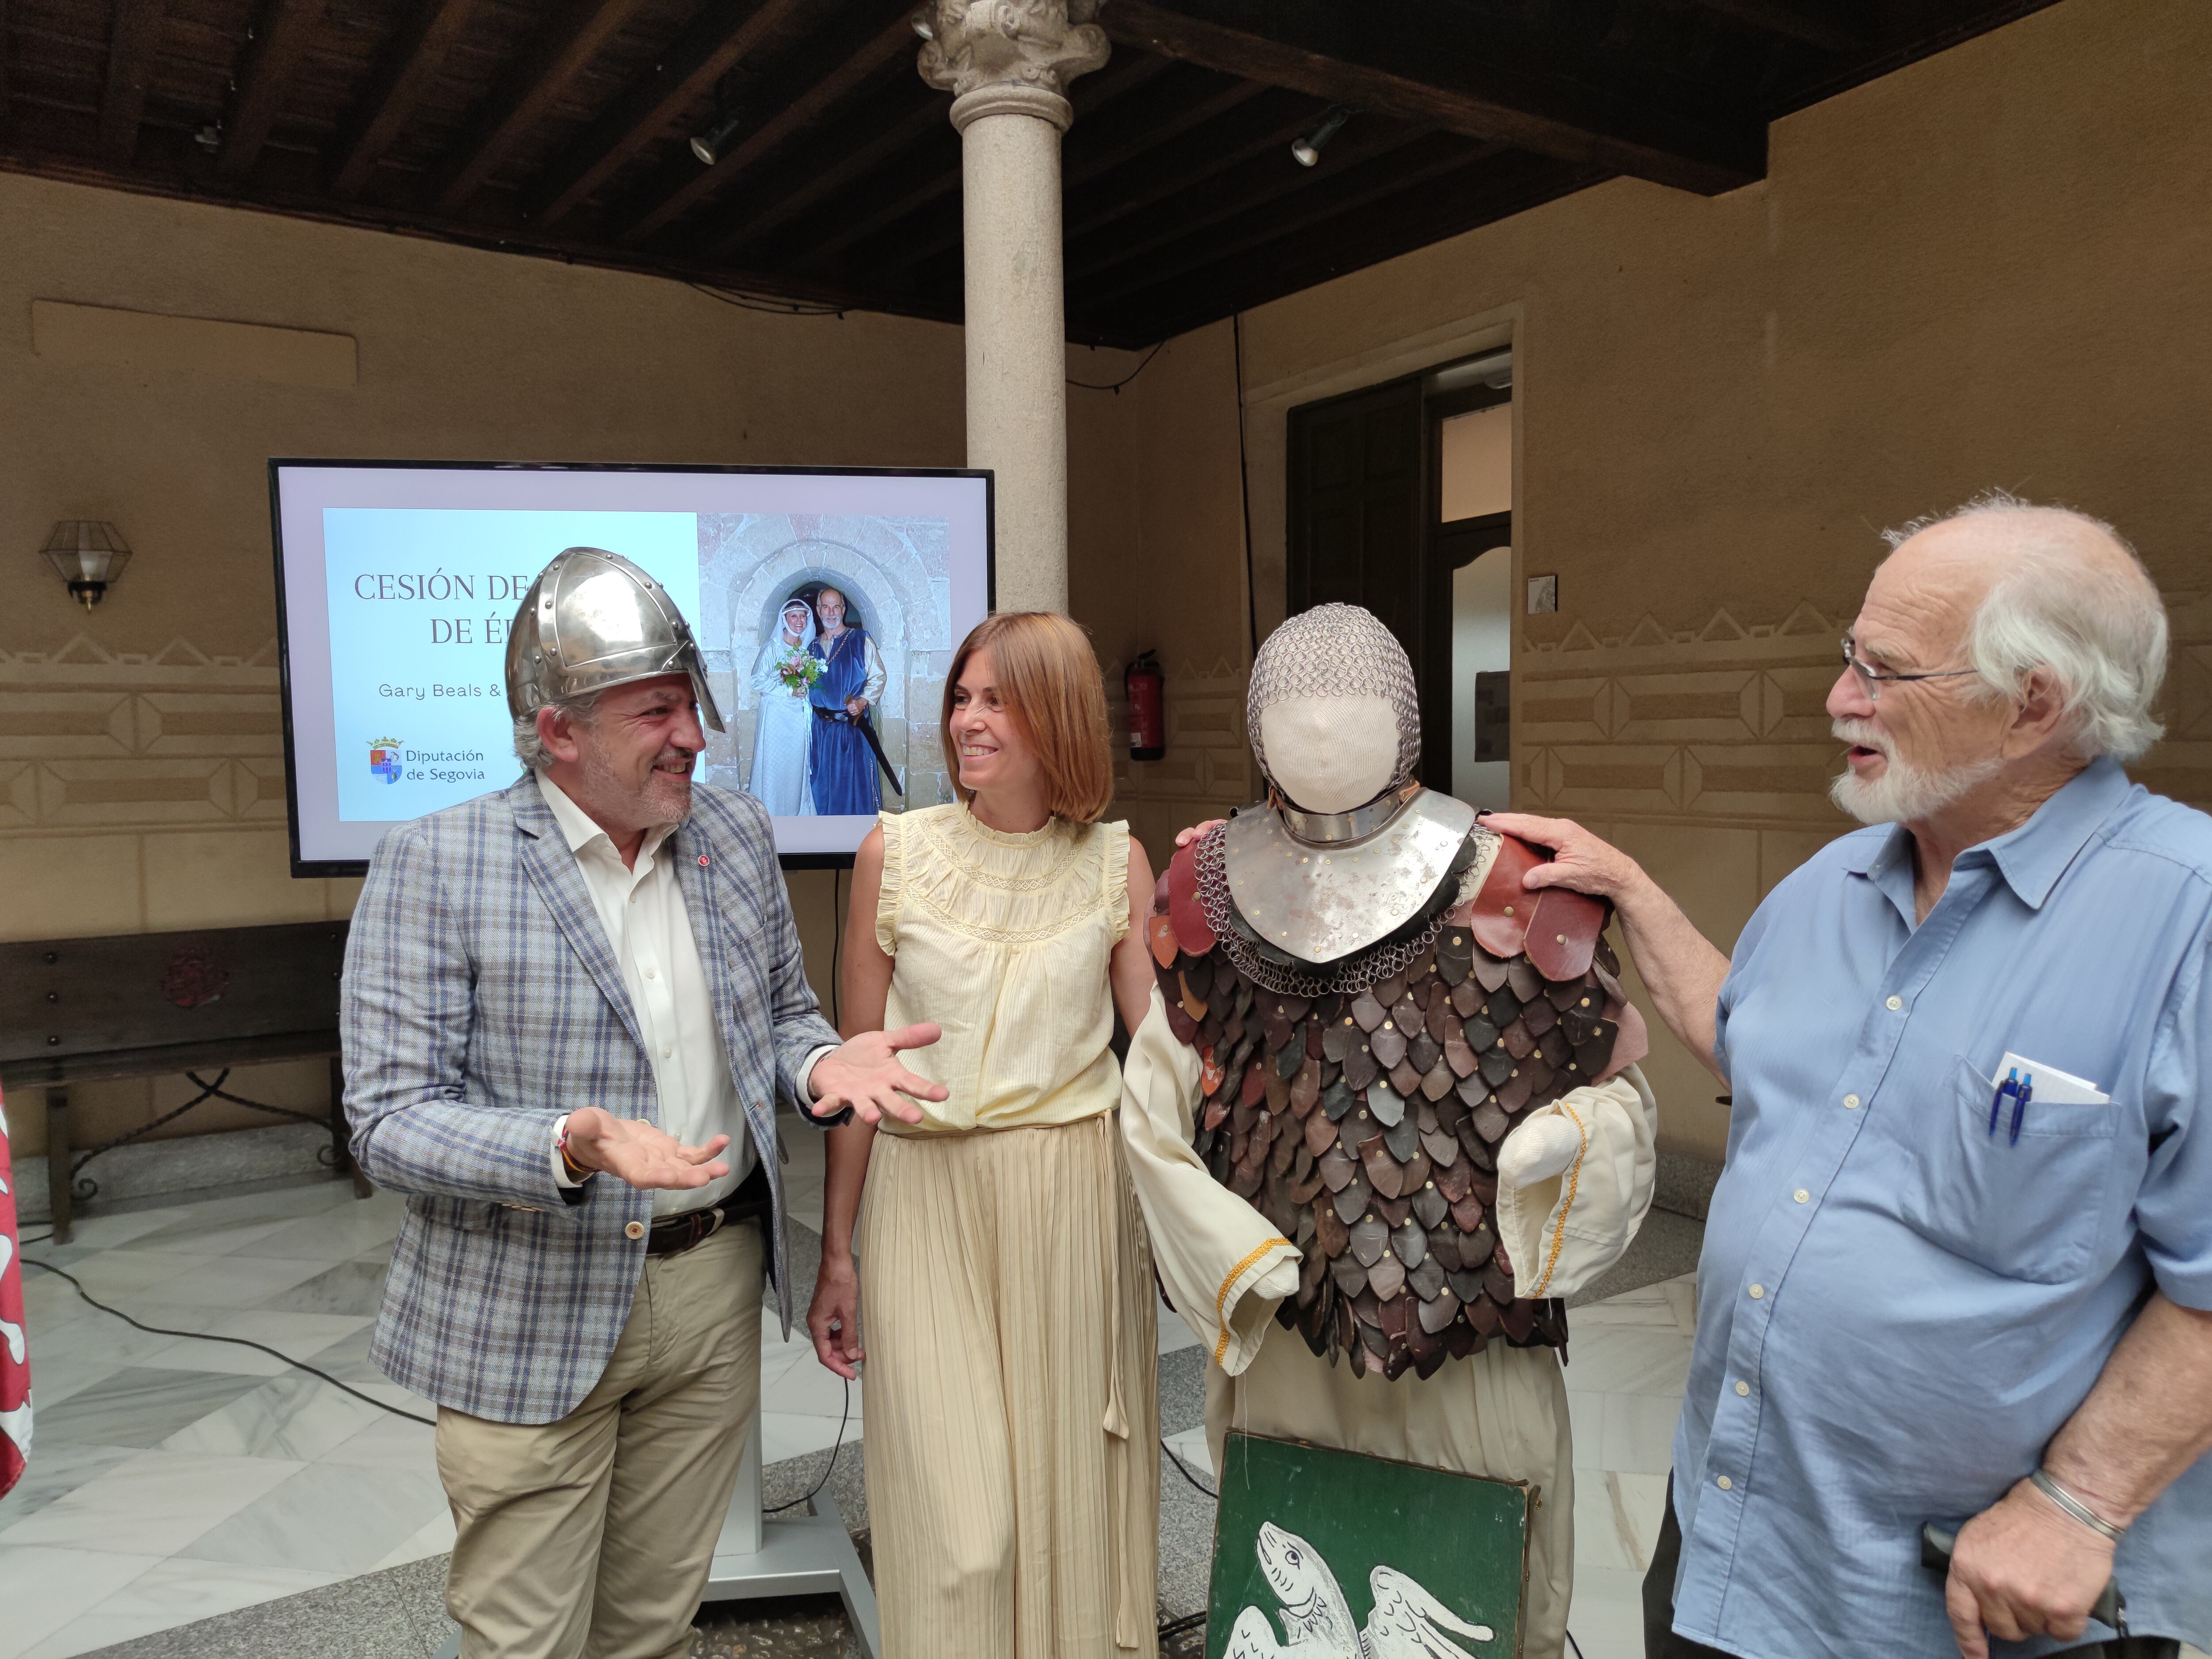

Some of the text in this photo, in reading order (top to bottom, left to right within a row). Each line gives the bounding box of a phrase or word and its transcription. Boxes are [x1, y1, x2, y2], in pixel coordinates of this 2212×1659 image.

[355, 567, 528, 600] CESIÓN DE
[430, 619, 472, 644] DE
[379, 684, 501, 700] Gary Beals &
[406, 749, 484, 764] Diputación
[407, 769, 485, 783] de Segovia
